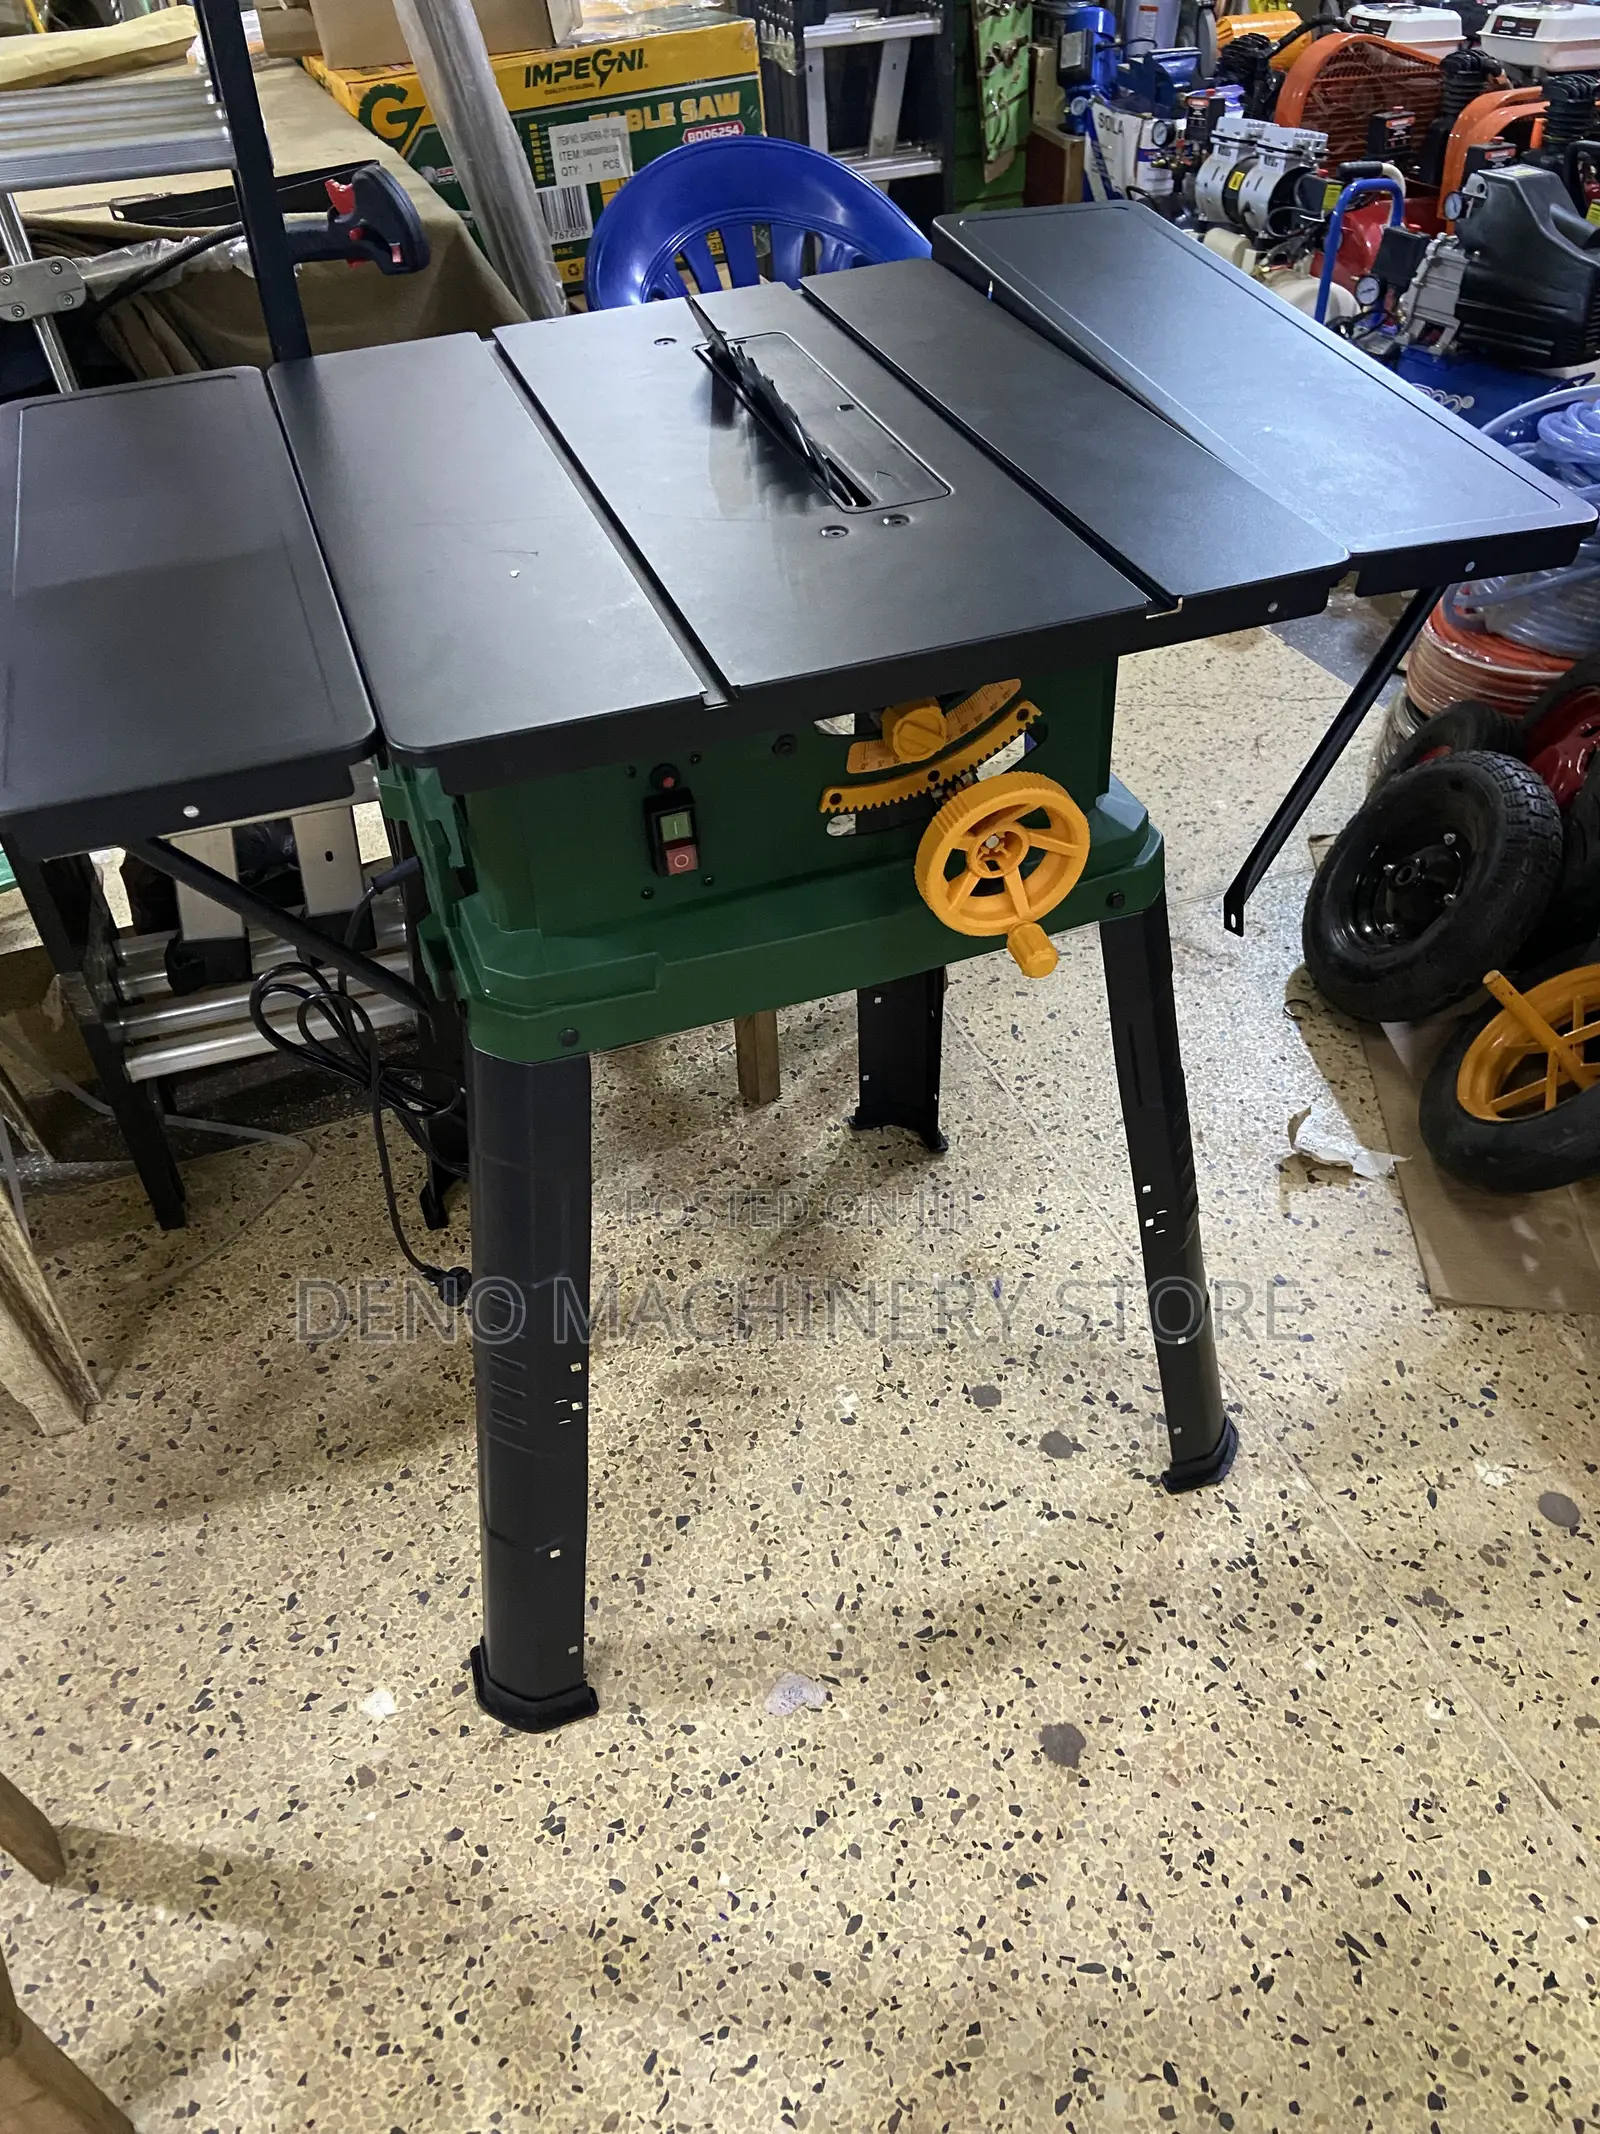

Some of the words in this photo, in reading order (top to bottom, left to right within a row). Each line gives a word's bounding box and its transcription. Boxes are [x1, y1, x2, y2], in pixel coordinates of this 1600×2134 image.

[525, 48, 645, 89] IMPEGNI
[680, 91, 741, 124] SAW
[602, 159, 621, 170] PCS
